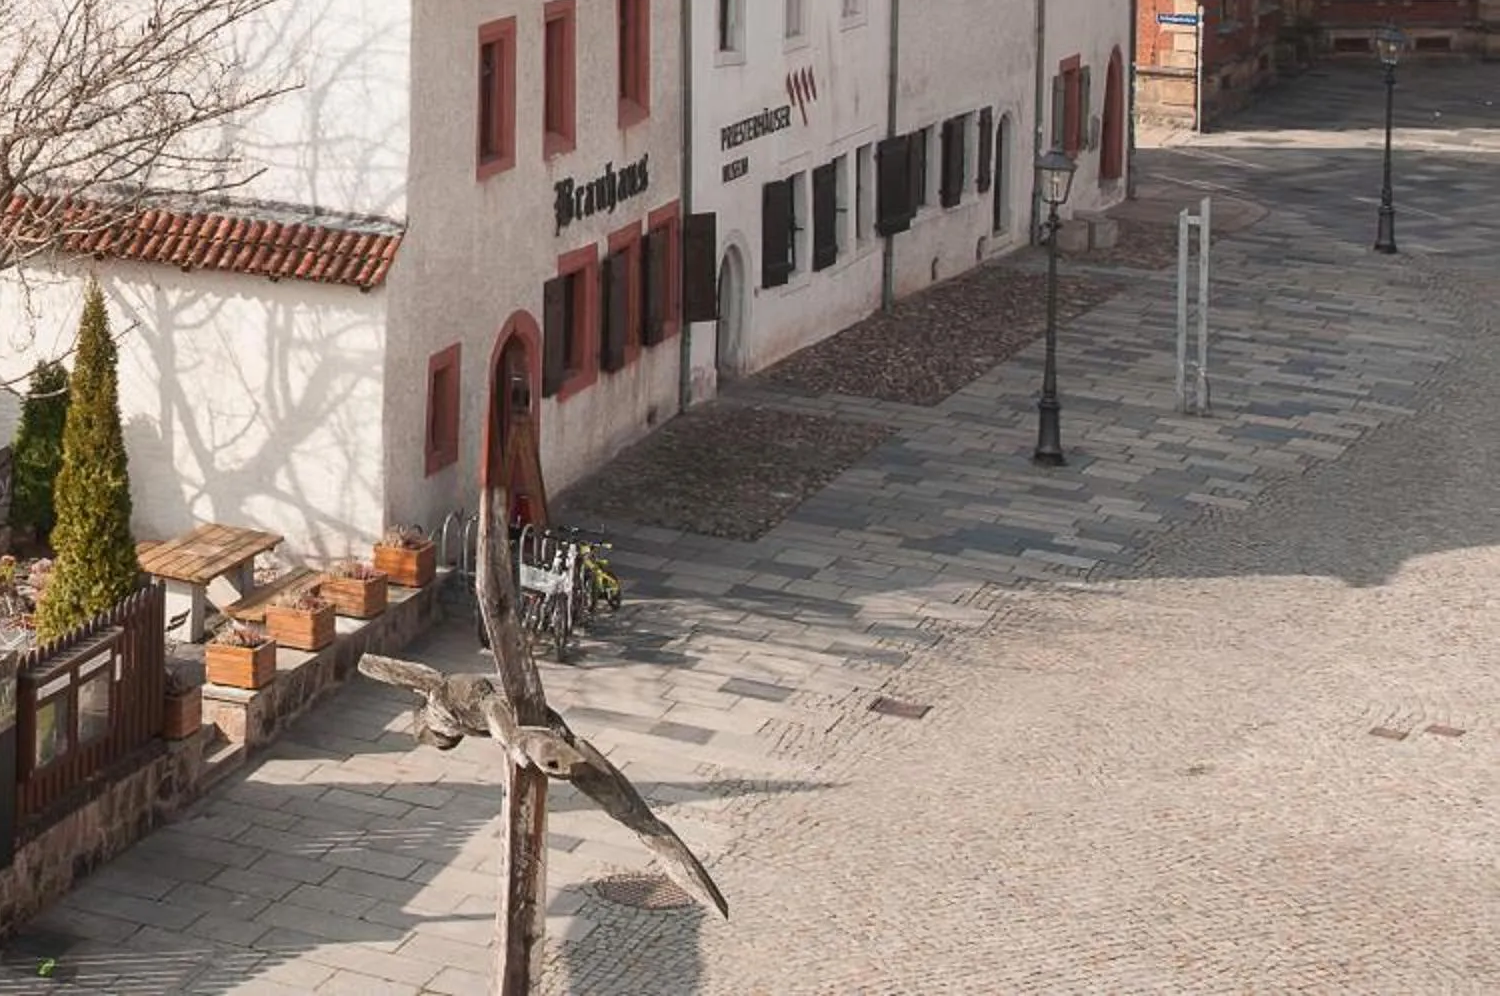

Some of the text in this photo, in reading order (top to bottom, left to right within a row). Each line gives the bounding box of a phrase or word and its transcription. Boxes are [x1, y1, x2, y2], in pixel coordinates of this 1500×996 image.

[721, 105, 791, 151] PRIESTERHÄUSER
[722, 156, 749, 183] MUSEUM
[554, 152, 649, 237] Brauhaus
